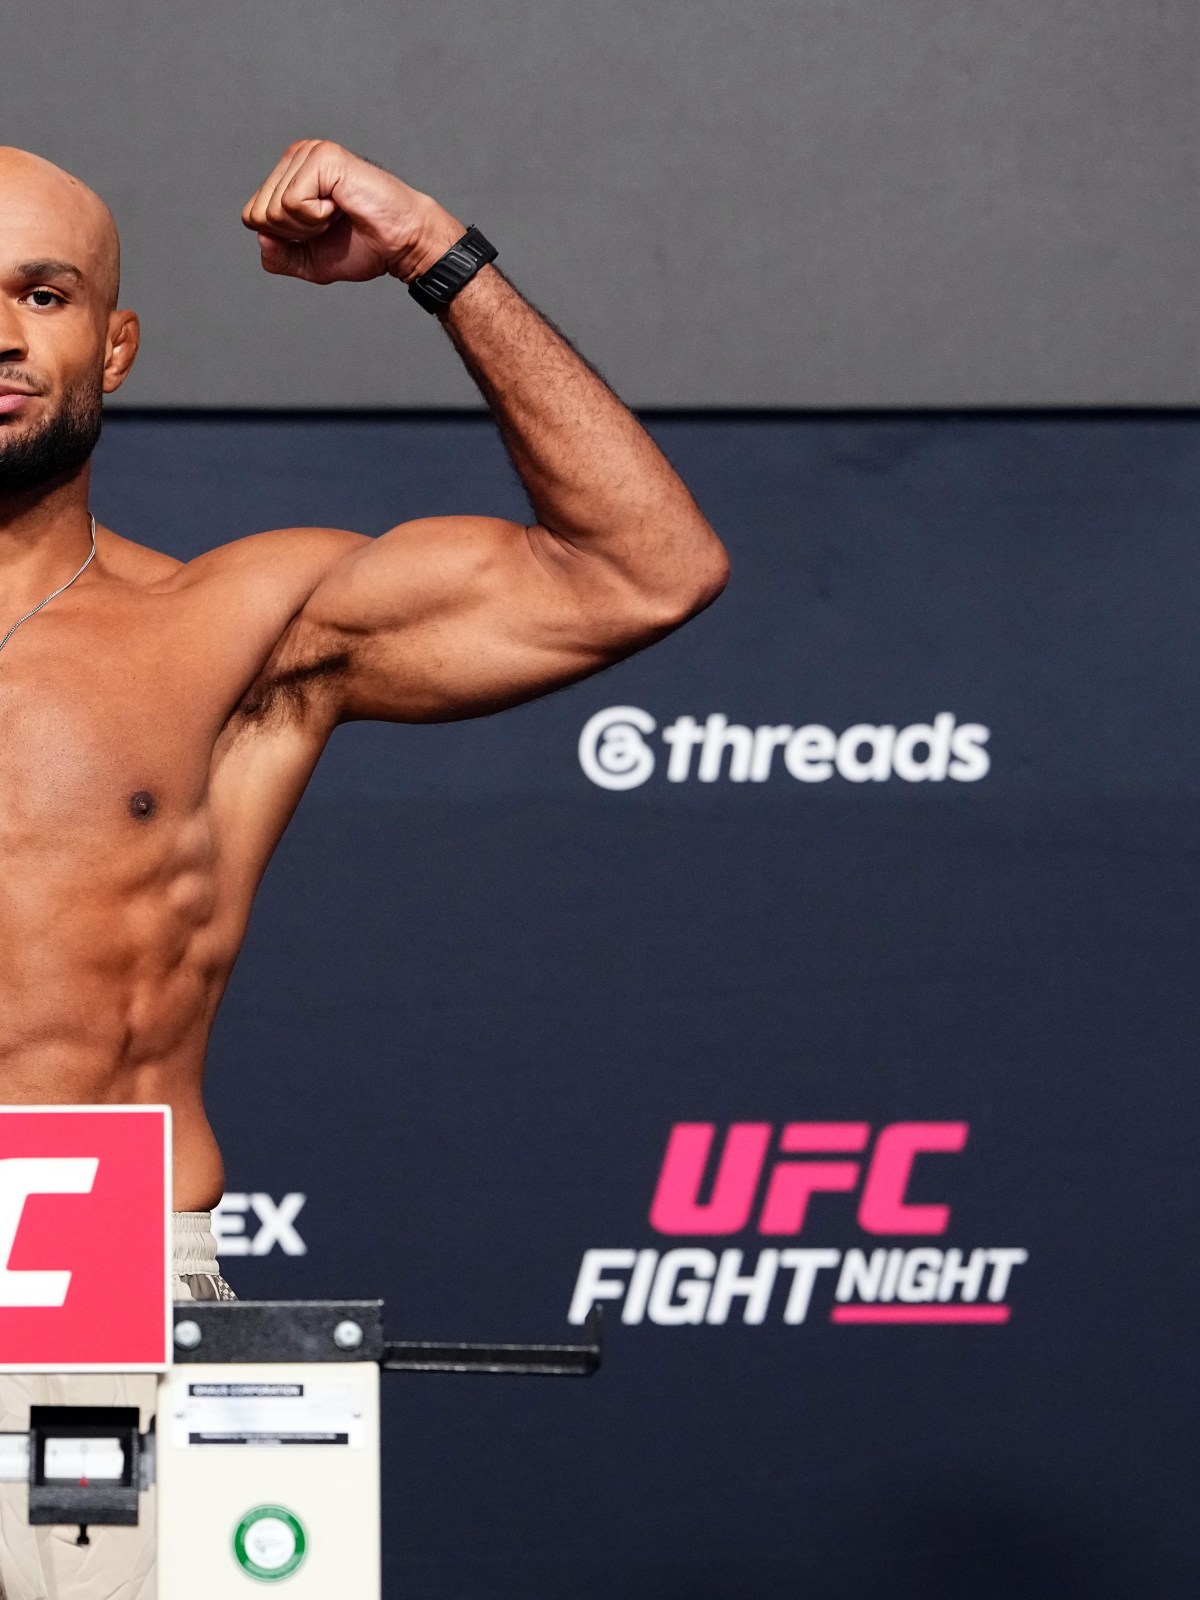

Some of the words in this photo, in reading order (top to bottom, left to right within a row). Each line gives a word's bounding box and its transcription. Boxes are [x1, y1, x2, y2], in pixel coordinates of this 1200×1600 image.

[662, 712, 991, 782] threads
[649, 1122, 968, 1235] UFC
[567, 1248, 840, 1325] FIGHT
[834, 1248, 1028, 1302] NIGHT
